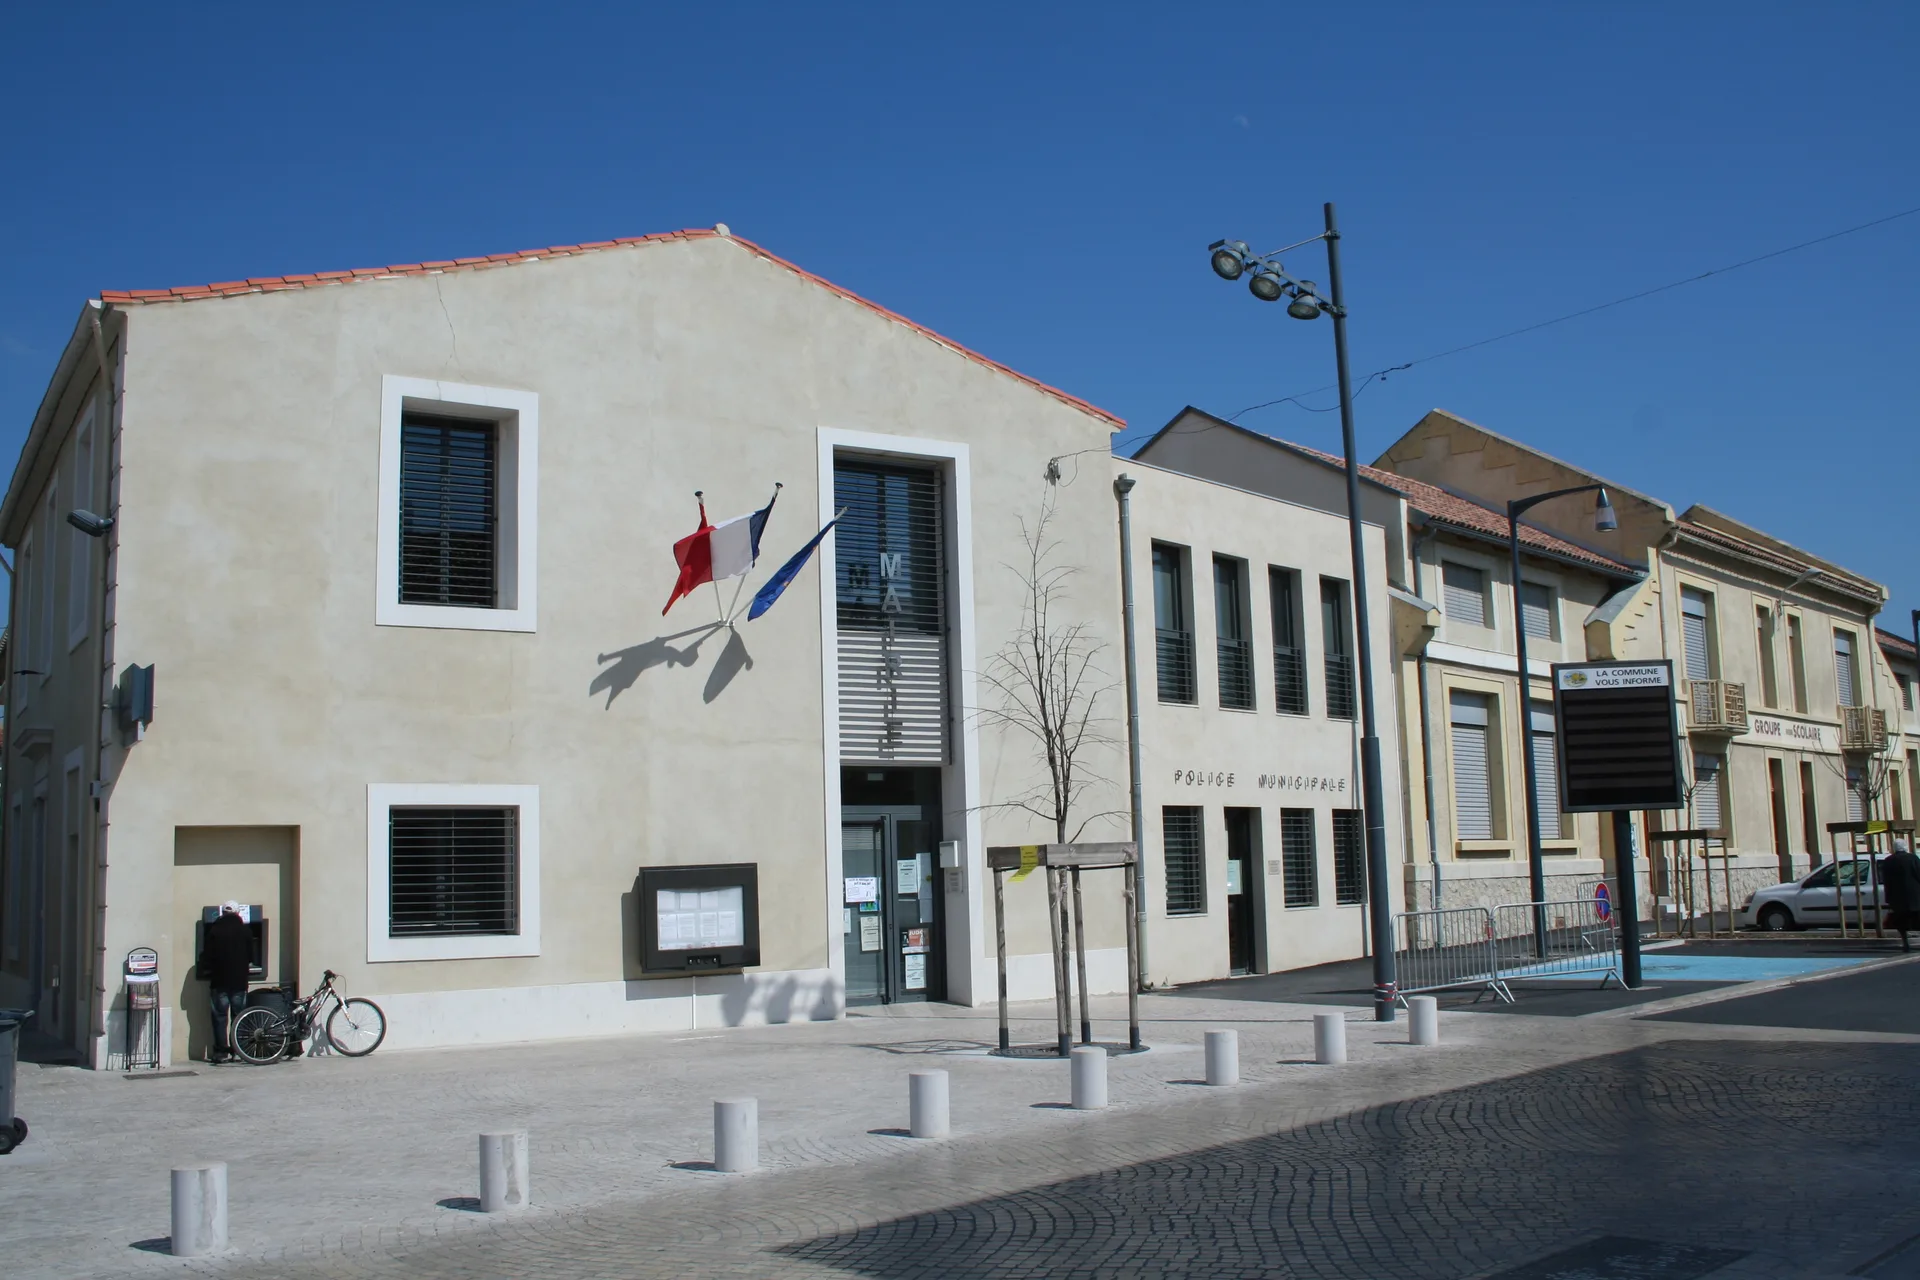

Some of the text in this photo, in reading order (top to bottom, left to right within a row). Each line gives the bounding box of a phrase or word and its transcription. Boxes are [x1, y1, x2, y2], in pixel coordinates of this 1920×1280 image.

[879, 552, 903, 744] MAIRIE
[1595, 676, 1662, 686] VOUS INFORME
[1596, 667, 1658, 677] LA COMMUNE
[1754, 718, 1782, 737] GROUPE
[1793, 724, 1821, 742] SCOLAIRE
[1175, 769, 1345, 791] POLICE MUNICIPALE
